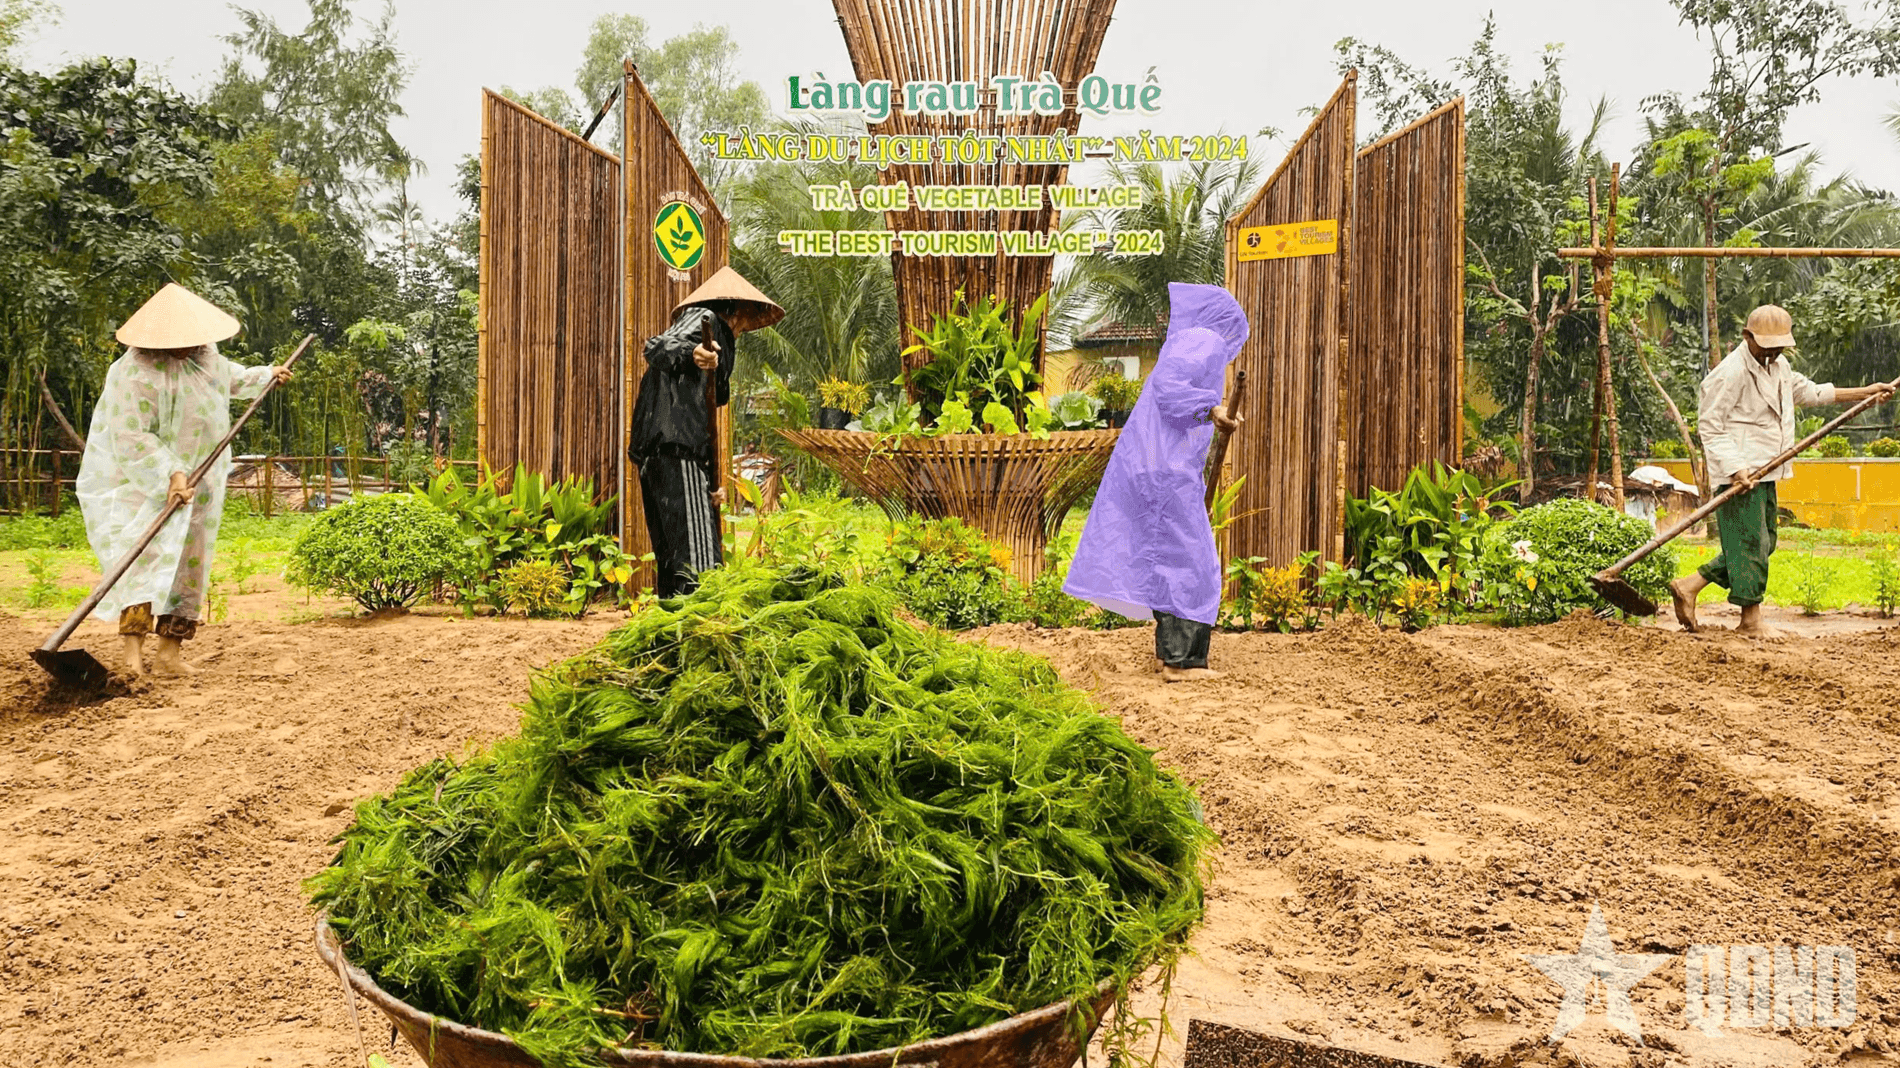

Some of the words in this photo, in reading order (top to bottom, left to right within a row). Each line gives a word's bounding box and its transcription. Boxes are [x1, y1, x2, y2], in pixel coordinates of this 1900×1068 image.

[787, 71, 892, 119] Làng
[905, 83, 977, 112] rau
[993, 74, 1063, 112] Trà
[1080, 65, 1162, 115] Quế
[701, 127, 800, 161] “LÀNG
[806, 135, 850, 161] DU
[858, 135, 932, 169] LỊCH
[940, 130, 998, 163] TỐT
[1113, 129, 1183, 162] NĂM
[1188, 135, 1248, 161] 2024
[811, 183, 855, 208] TRÀ
[916, 187, 1041, 208] VEGETABLE
[1051, 186, 1141, 207] VILLAGE
[780, 233, 832, 254] “THE
[839, 233, 894, 253] BEST
[902, 232, 995, 254] TOURISM
[1115, 232, 1162, 253] 2024
